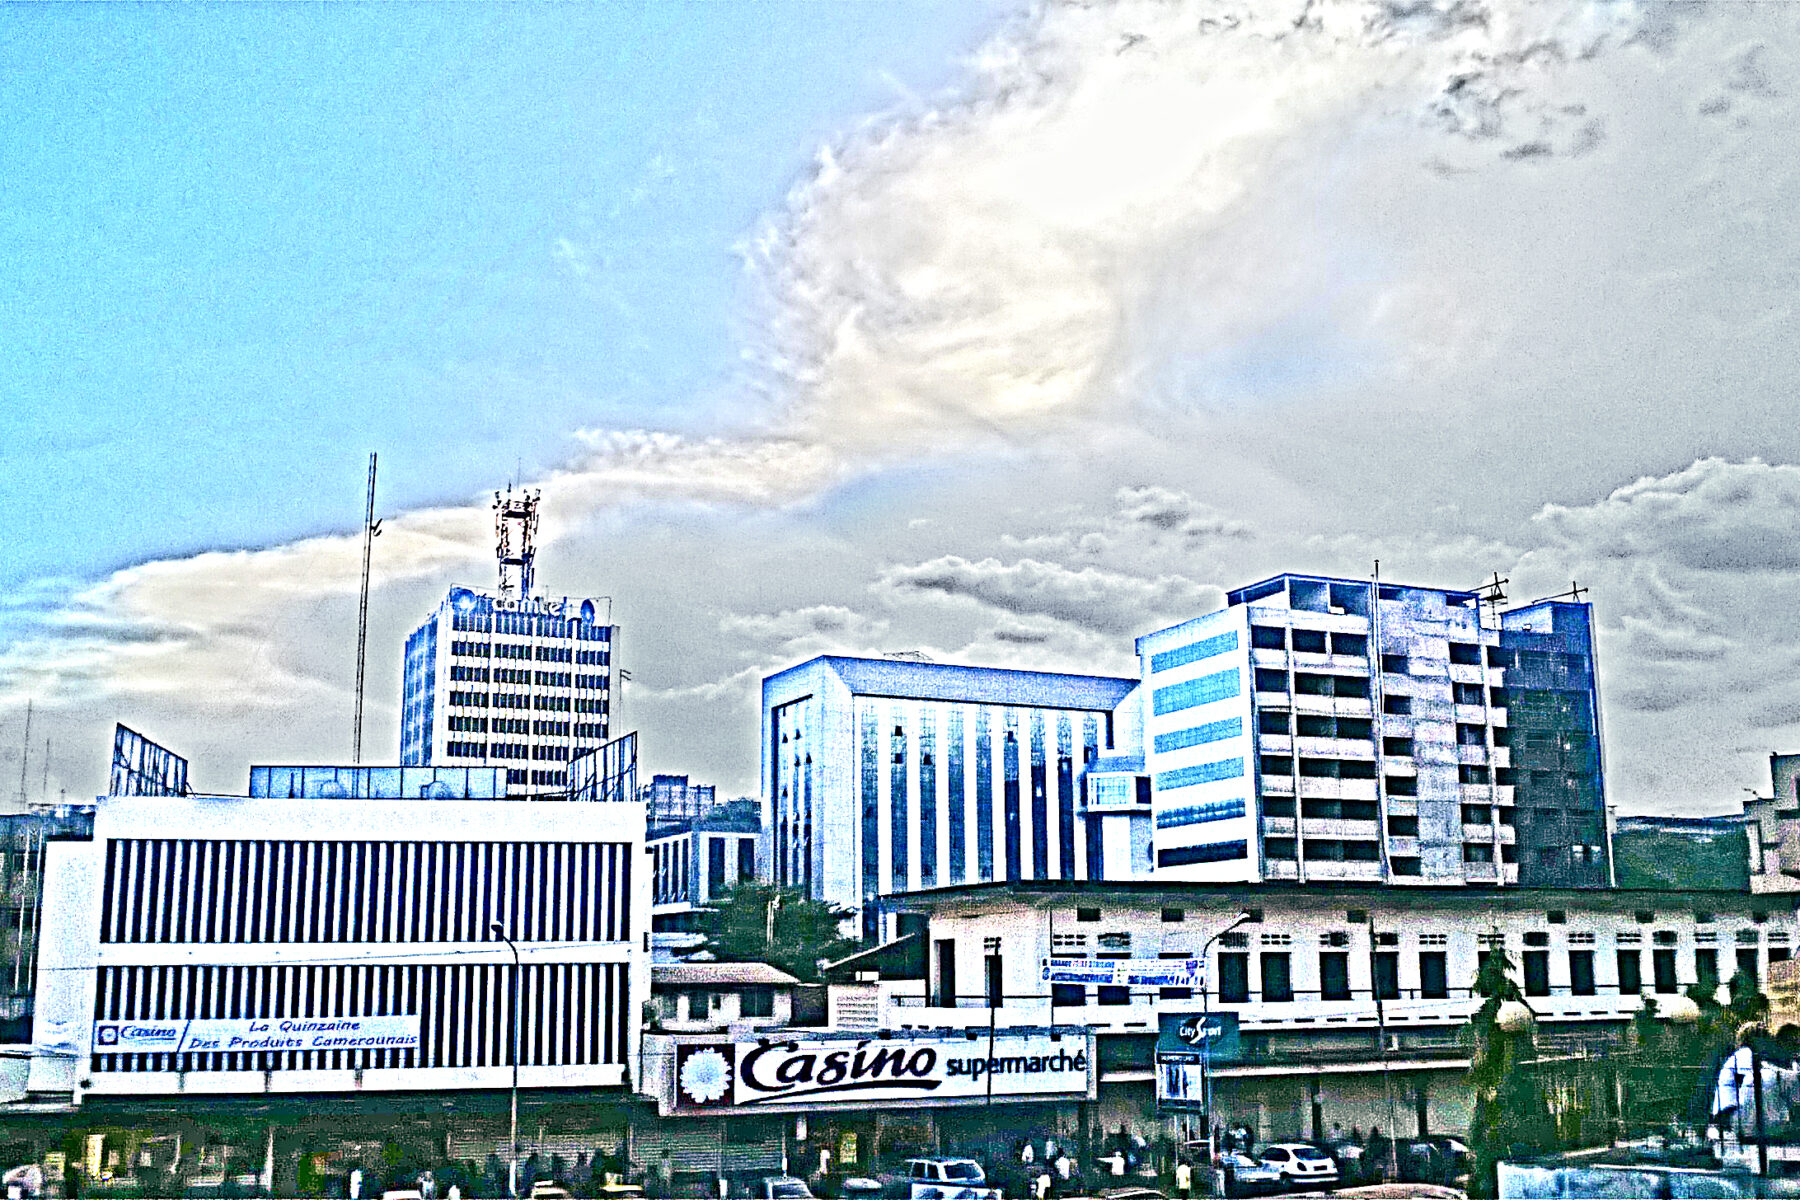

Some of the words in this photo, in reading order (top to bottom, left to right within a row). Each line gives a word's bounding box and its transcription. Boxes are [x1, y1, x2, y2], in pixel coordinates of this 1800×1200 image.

[121, 1025, 176, 1039] Casino
[249, 1021, 269, 1032] La
[280, 1020, 360, 1033] Quinzaine
[188, 1037, 220, 1049] Des
[228, 1036, 303, 1049] Produits
[312, 1034, 418, 1047] Camerounais
[740, 1040, 937, 1092] Casino
[946, 1048, 1086, 1081] supermarché
